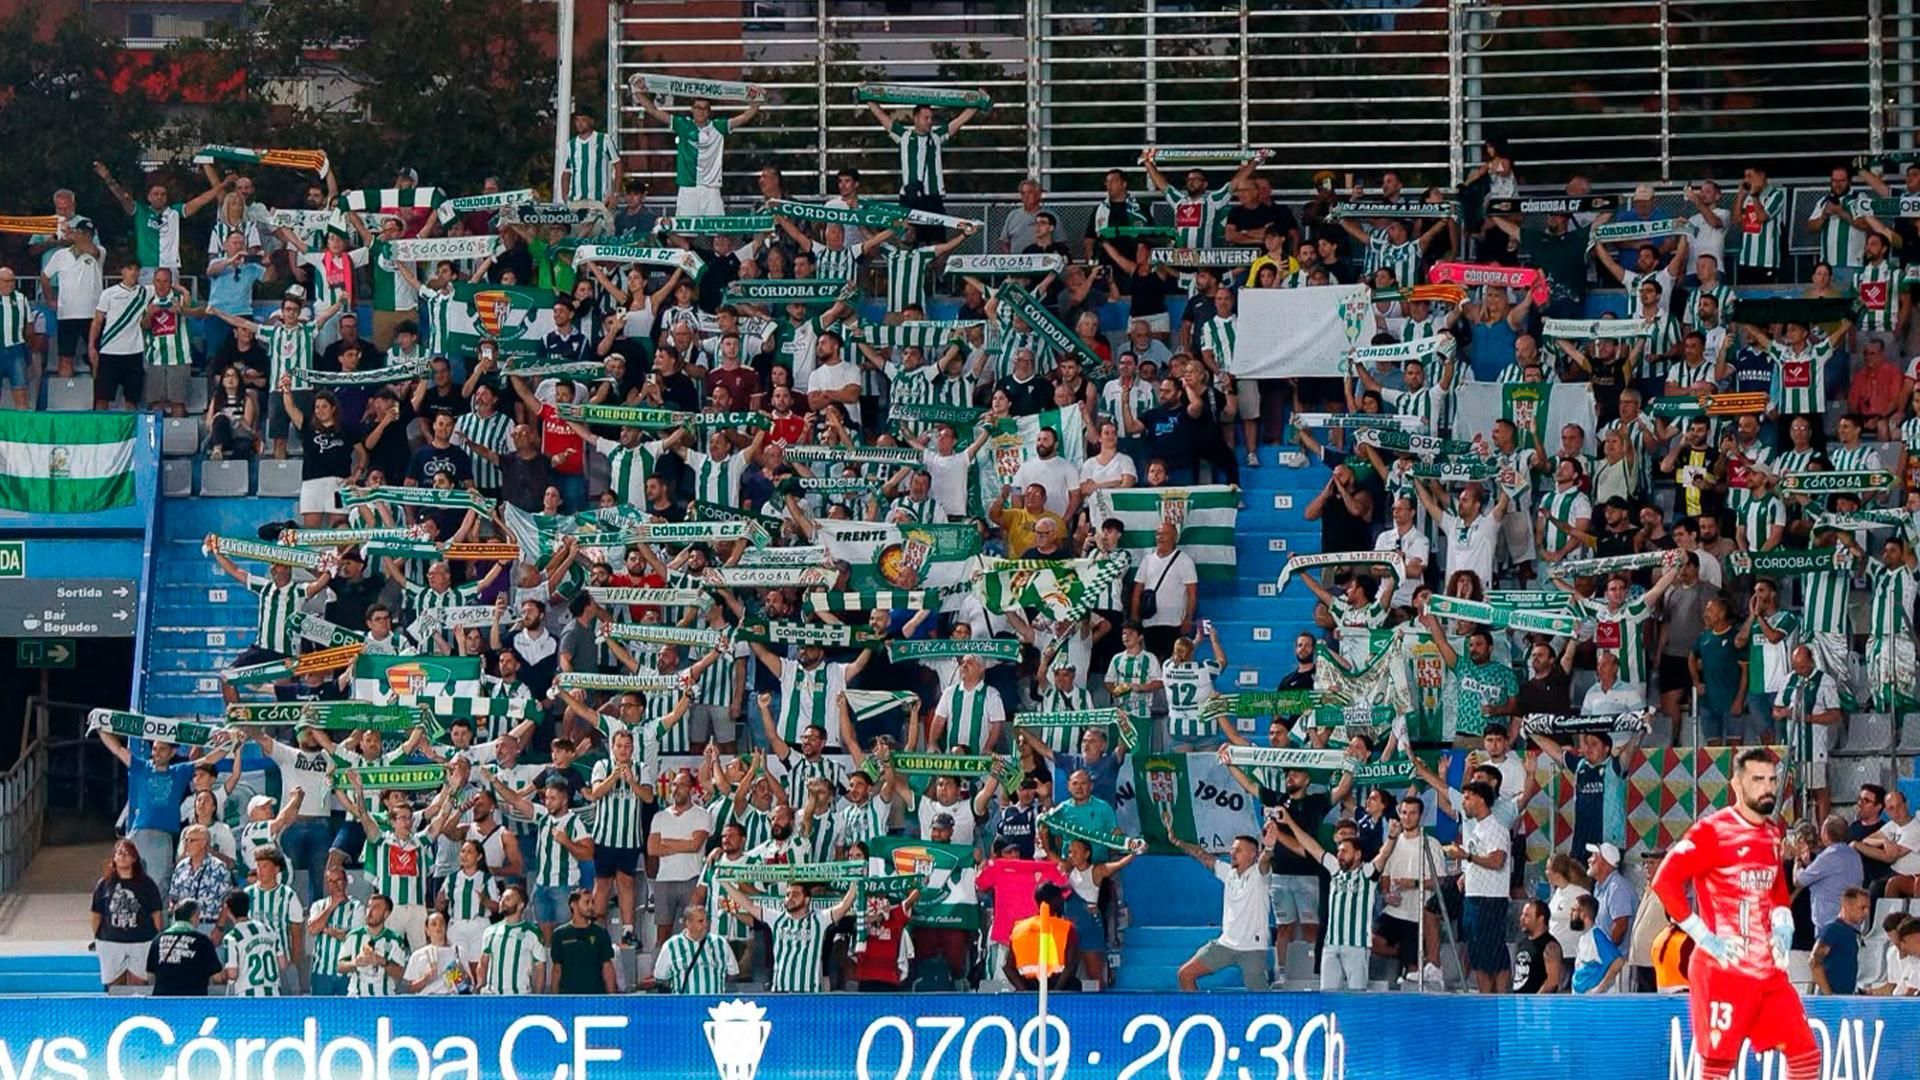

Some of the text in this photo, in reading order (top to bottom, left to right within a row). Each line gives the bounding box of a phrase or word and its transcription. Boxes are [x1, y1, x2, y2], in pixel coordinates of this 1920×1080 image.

[1568, 199, 1583, 212] CF
[657, 249, 676, 262] CF
[818, 284, 838, 297] CF
[1803, 473, 1862, 489] CÓRDOBA
[720, 523, 743, 536] C.F.
[836, 530, 888, 542] FRENTE
[1273, 541, 1283, 549] 12
[1815, 555, 1831, 566] CF
[732, 568, 791, 582] CÓRDOBA
[57, 587, 102, 598] Sortida
[44, 610, 66, 621] Bar
[451, 607, 497, 621] CÓRDO
[44, 622, 98, 635] Begudes
[829, 629, 845, 640] CF
[1168, 682, 1198, 706] 12
[258, 705, 302, 721] CÓRD
[1194, 780, 1244, 812] 1960
[249, 949, 279, 986] 20
[1709, 1001, 1734, 1031] 13
[0, 1015, 630, 1080] vs Córdoba CF
